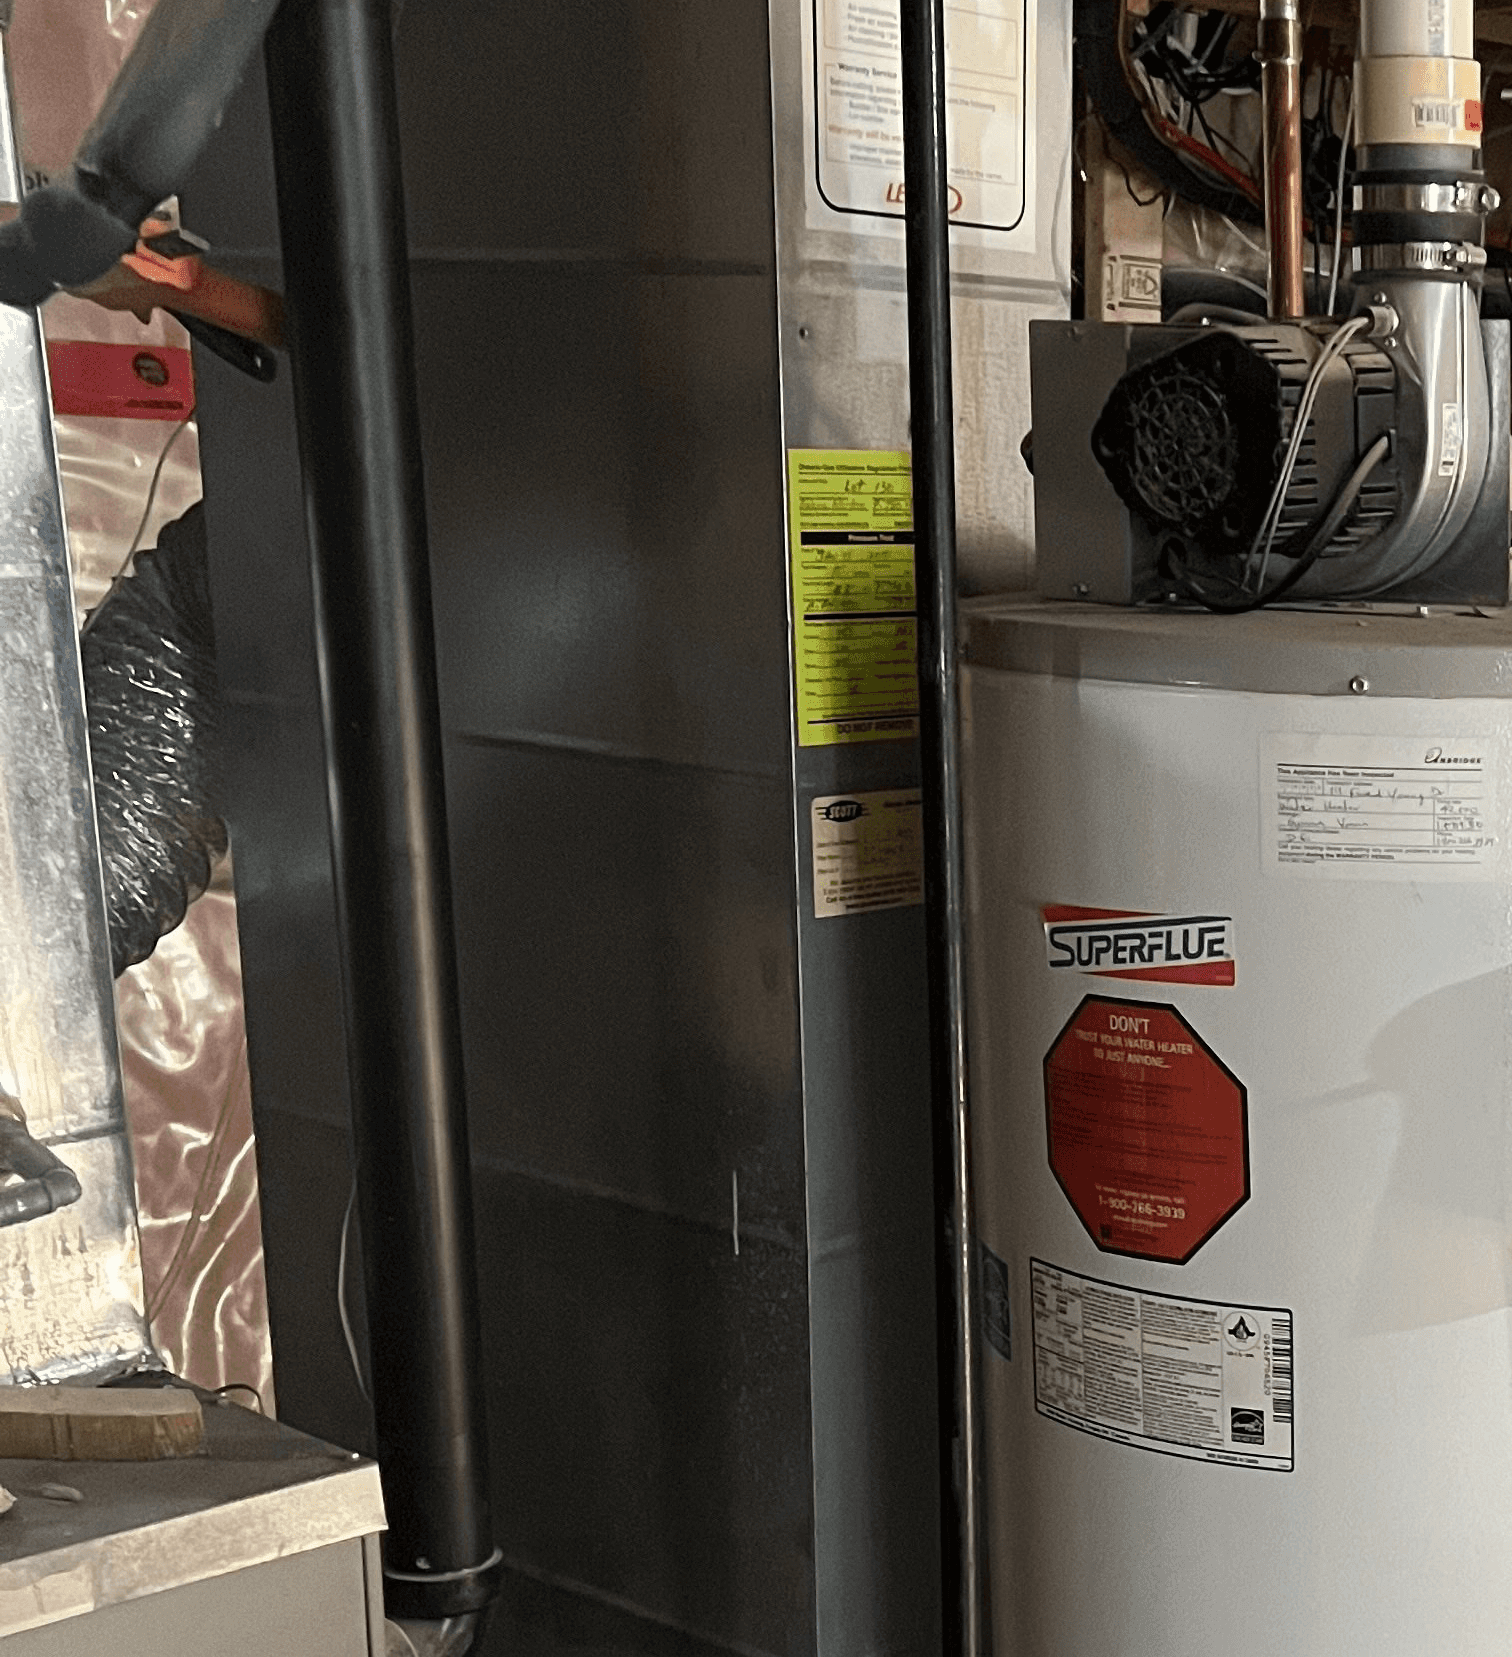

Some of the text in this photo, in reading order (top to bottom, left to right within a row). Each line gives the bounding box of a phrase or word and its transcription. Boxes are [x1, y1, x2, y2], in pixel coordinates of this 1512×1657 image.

[1049, 916, 1232, 968] SUPERFLUE
[1109, 1014, 1150, 1034] DON'T
[1100, 1034, 1123, 1047] YOUR
[1124, 1037, 1155, 1051] WATER
[1157, 1042, 1193, 1055] HEATER
